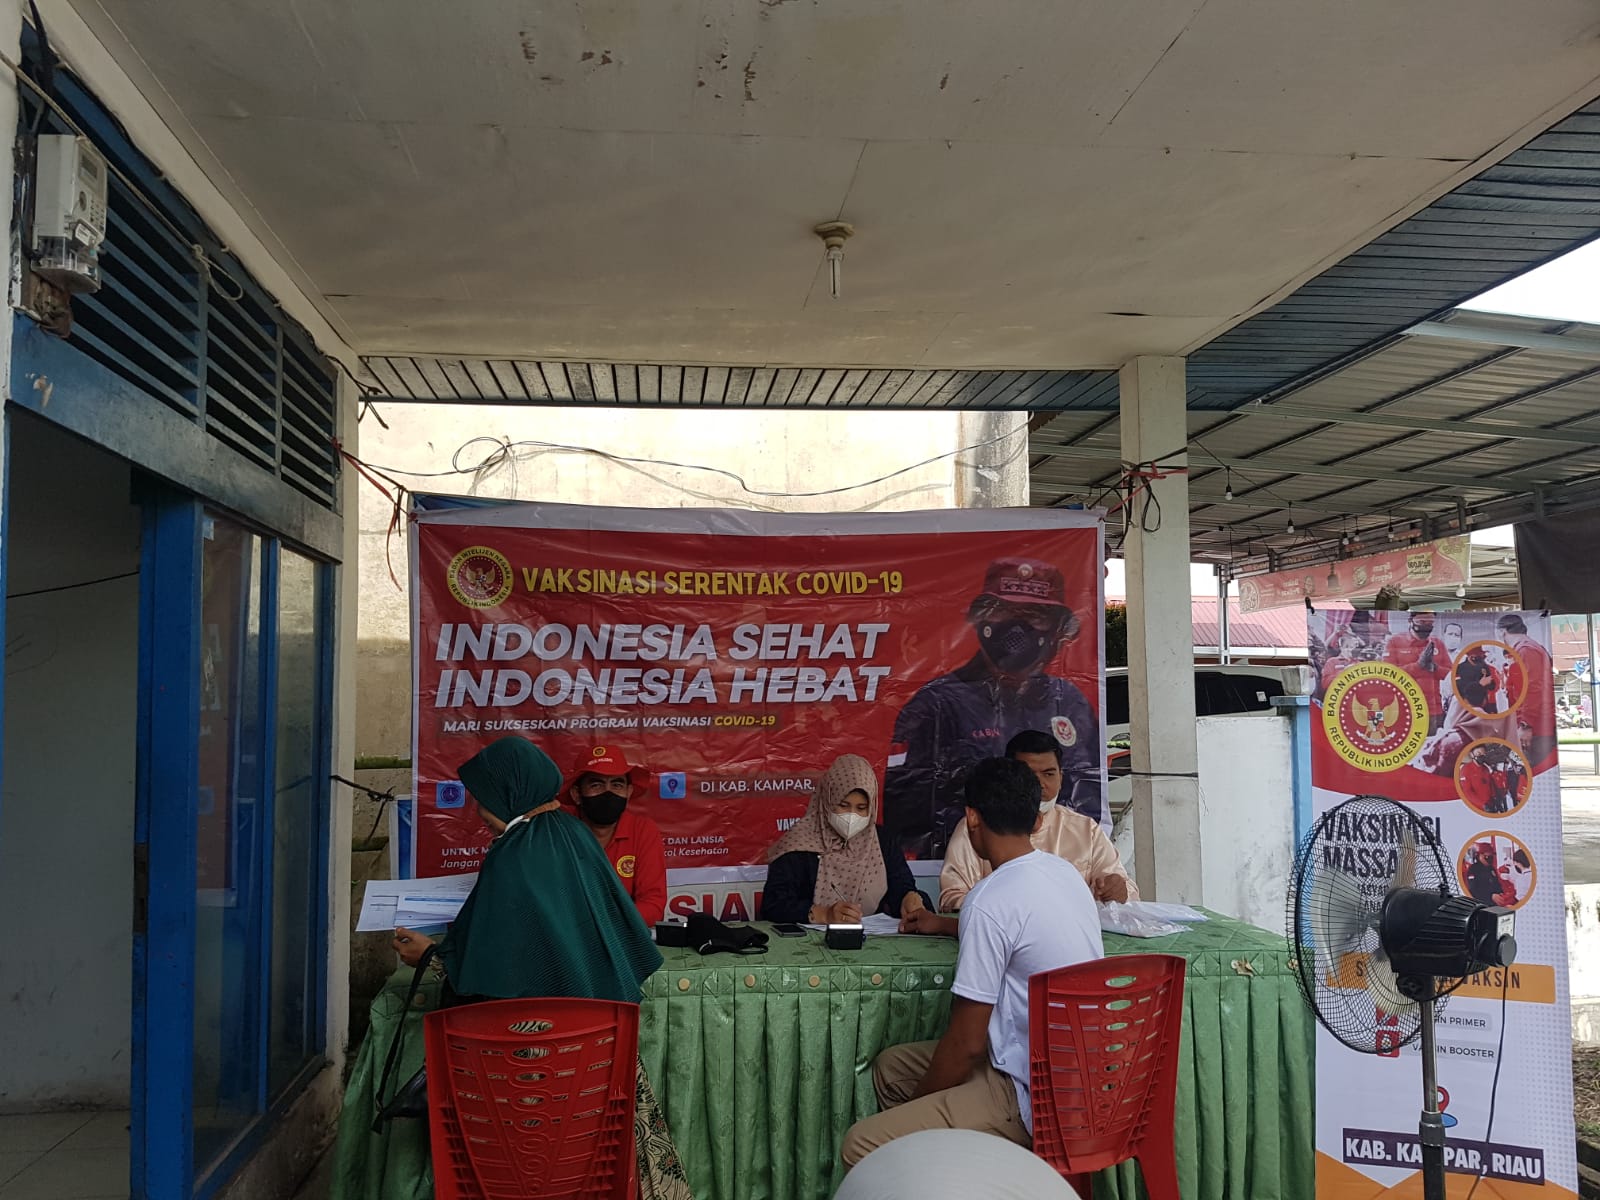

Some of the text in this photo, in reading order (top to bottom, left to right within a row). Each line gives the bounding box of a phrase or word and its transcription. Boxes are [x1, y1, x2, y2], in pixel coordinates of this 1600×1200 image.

[522, 567, 903, 595] VAKSINASI SERENTAK COVID-19
[435, 623, 890, 662] INDONESIA SEHAT
[434, 666, 891, 707] INDONESIA HEBAT
[1327, 666, 1424, 720] BADAN INTELIJEN NEGARA
[443, 715, 776, 732] MARI SUKSESKAN PROGRAM VAKSINASI COVID-19
[1328, 726, 1423, 768] REPUBLIK INDONESIA
[701, 779, 816, 793] DI KAB. KAMPAR,
[667, 837, 688, 845] DAN
[690, 835, 725, 845] LANSIA
[441, 847, 479, 857] UNTUK
[678, 846, 729, 857] Kesehatan
[440, 859, 480, 870] Jangan
[1449, 1016, 1487, 1028] PRIMER
[1449, 1046, 1495, 1058] BOOSTER
[1345, 1137, 1542, 1179] KAB. KAPAR, RIAU
